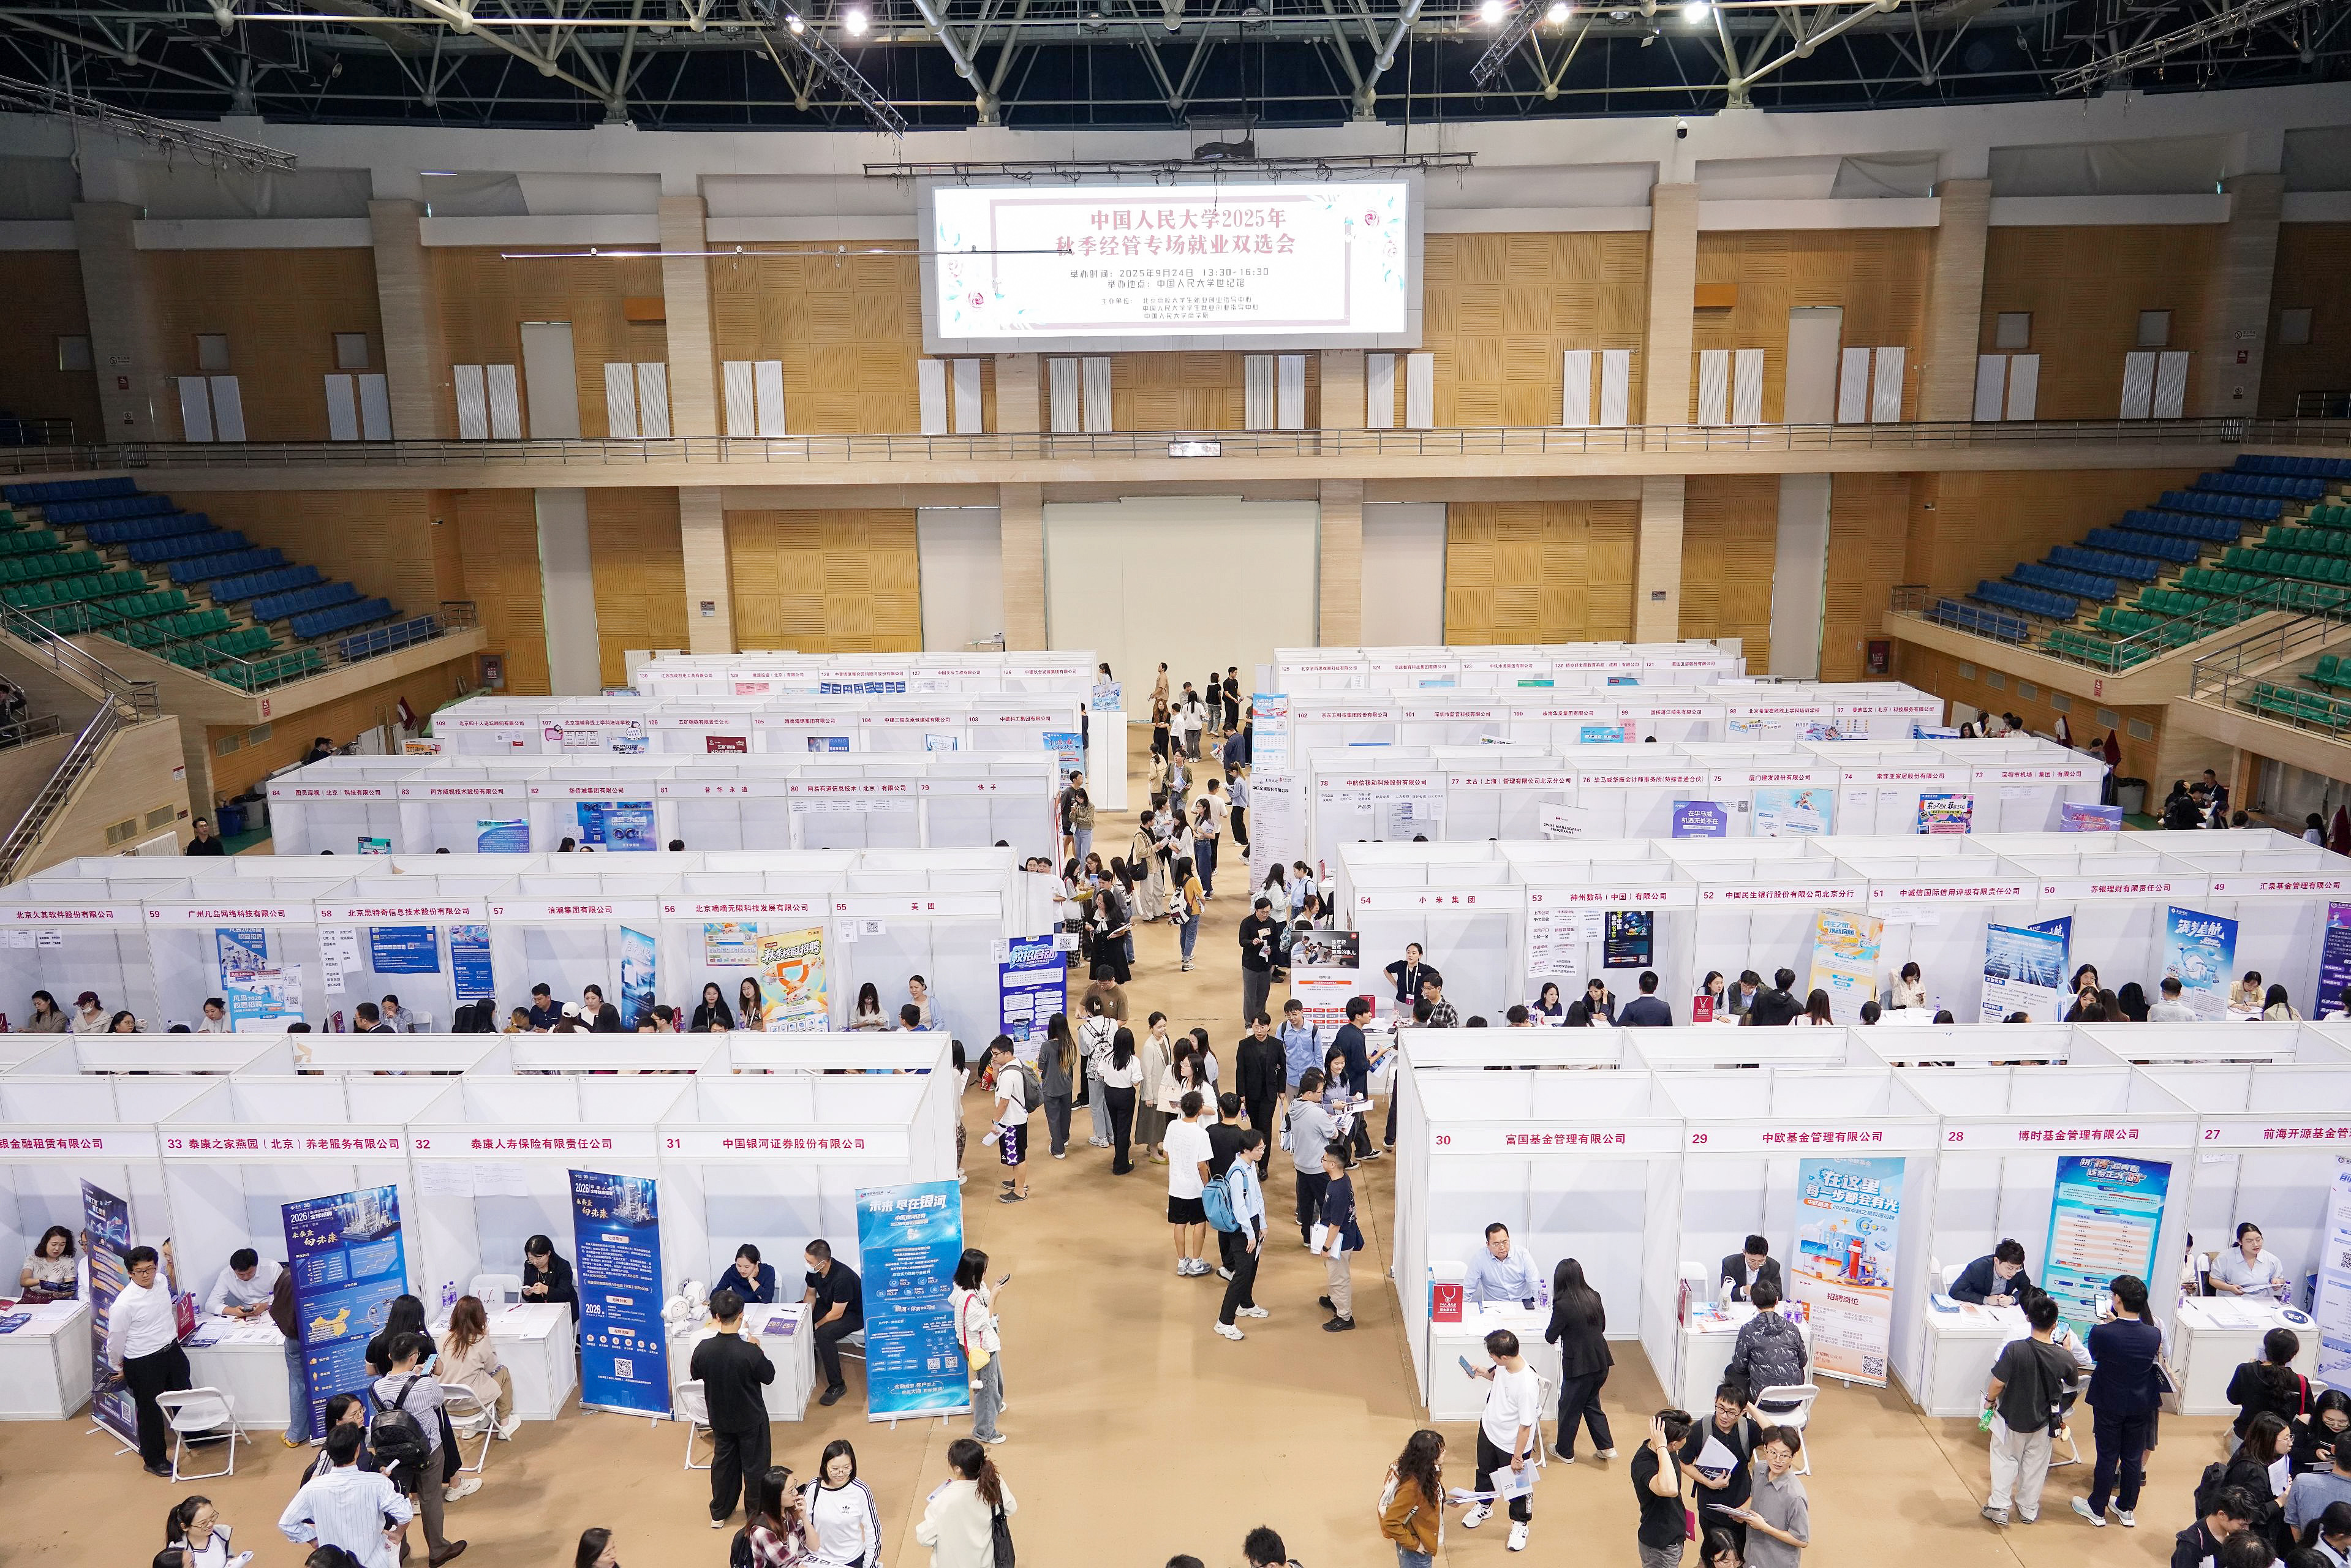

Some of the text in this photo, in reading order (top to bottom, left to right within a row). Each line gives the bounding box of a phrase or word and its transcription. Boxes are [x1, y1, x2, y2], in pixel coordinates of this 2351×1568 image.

[1091, 208, 1286, 230] 中国人民大学2025年
[1055, 233, 1296, 256] 秋季经管专场就业双选会
[1900, 888, 2019, 897] 中诚信国际信用评级有限责任公司
[349, 908, 469, 916] 北京思特奇信息技术股份有限公司
[761, 940, 821, 963] 秋季校园招聘
[1011, 949, 1054, 964] 校招启动
[1692, 1132, 1882, 1143] 29 中欧基金管理有限公司
[1949, 1129, 2138, 1141] 28 博时基金管理有限公司
[2205, 1128, 2351, 1139] 27 前海开源基金管
[0, 1139, 102, 1148] 银金融租赁有限公司
[168, 1139, 399, 1149] 33 泰康之家燕园（北京）养老服务有限公司
[416, 1139, 611, 1149] 32 泰康人寿保险有限责任公司
[667, 1139, 864, 1149] 31 中国银河证券股份有限公司
[1436, 1134, 1625, 1145] 30 富国基金管理有限公司
[575, 1183, 589, 1193] 2026
[1823, 1170, 1881, 1196] 在这里
[869, 1194, 947, 1212] 未来 尽在银河
[1805, 1183, 1900, 1214] 每一步都会有光
[1807, 1200, 1895, 1221] 中欧基金 2026届卓越之星校园招聘
[290, 1212, 308, 1223] 2026
[1827, 1292, 1860, 1305] 招聘岗位
[586, 1303, 601, 1314] 2026
